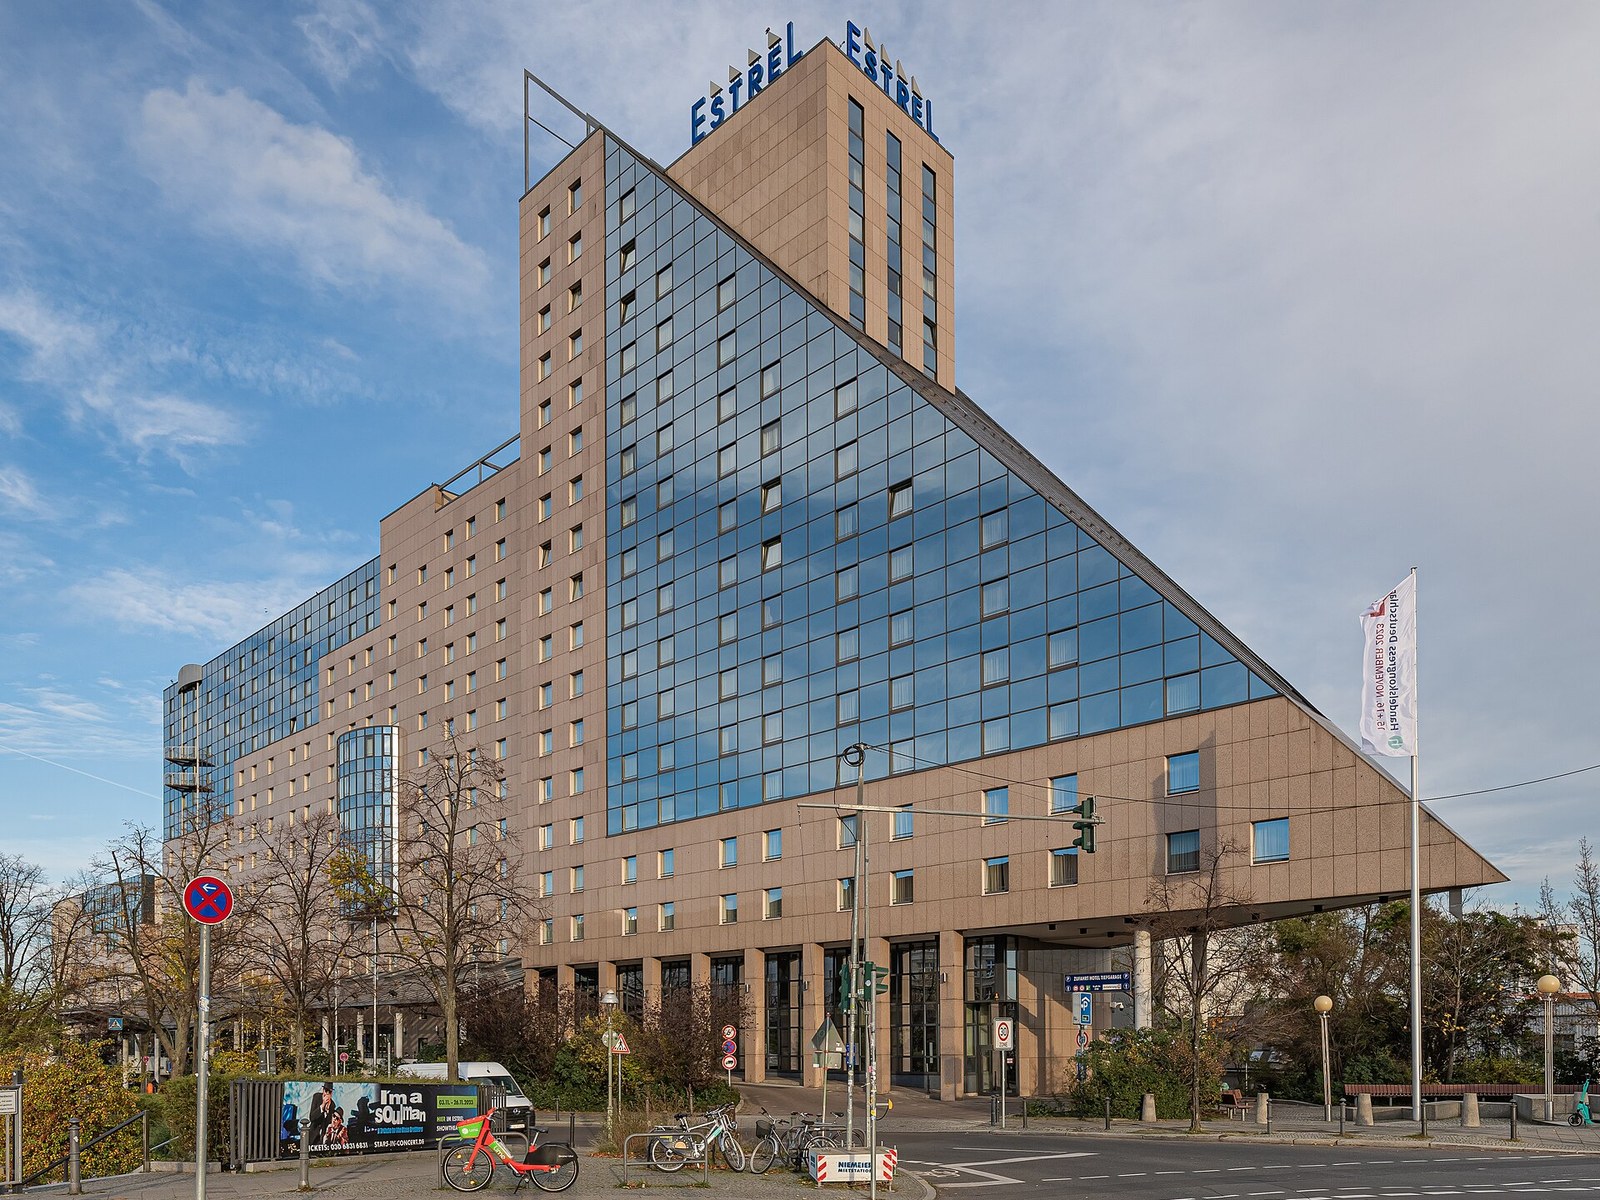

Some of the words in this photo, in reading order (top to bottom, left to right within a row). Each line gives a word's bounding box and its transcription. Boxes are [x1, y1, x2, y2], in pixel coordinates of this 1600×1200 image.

[691, 21, 803, 146] ESTREL
[846, 20, 939, 143] ESTREL
[1000, 1027, 1007, 1036] 30
[409, 1092, 423, 1104] a
[308, 1144, 330, 1152] ICKETS:
[342, 1142, 356, 1150] 6831
[355, 1141, 369, 1149] 6831
